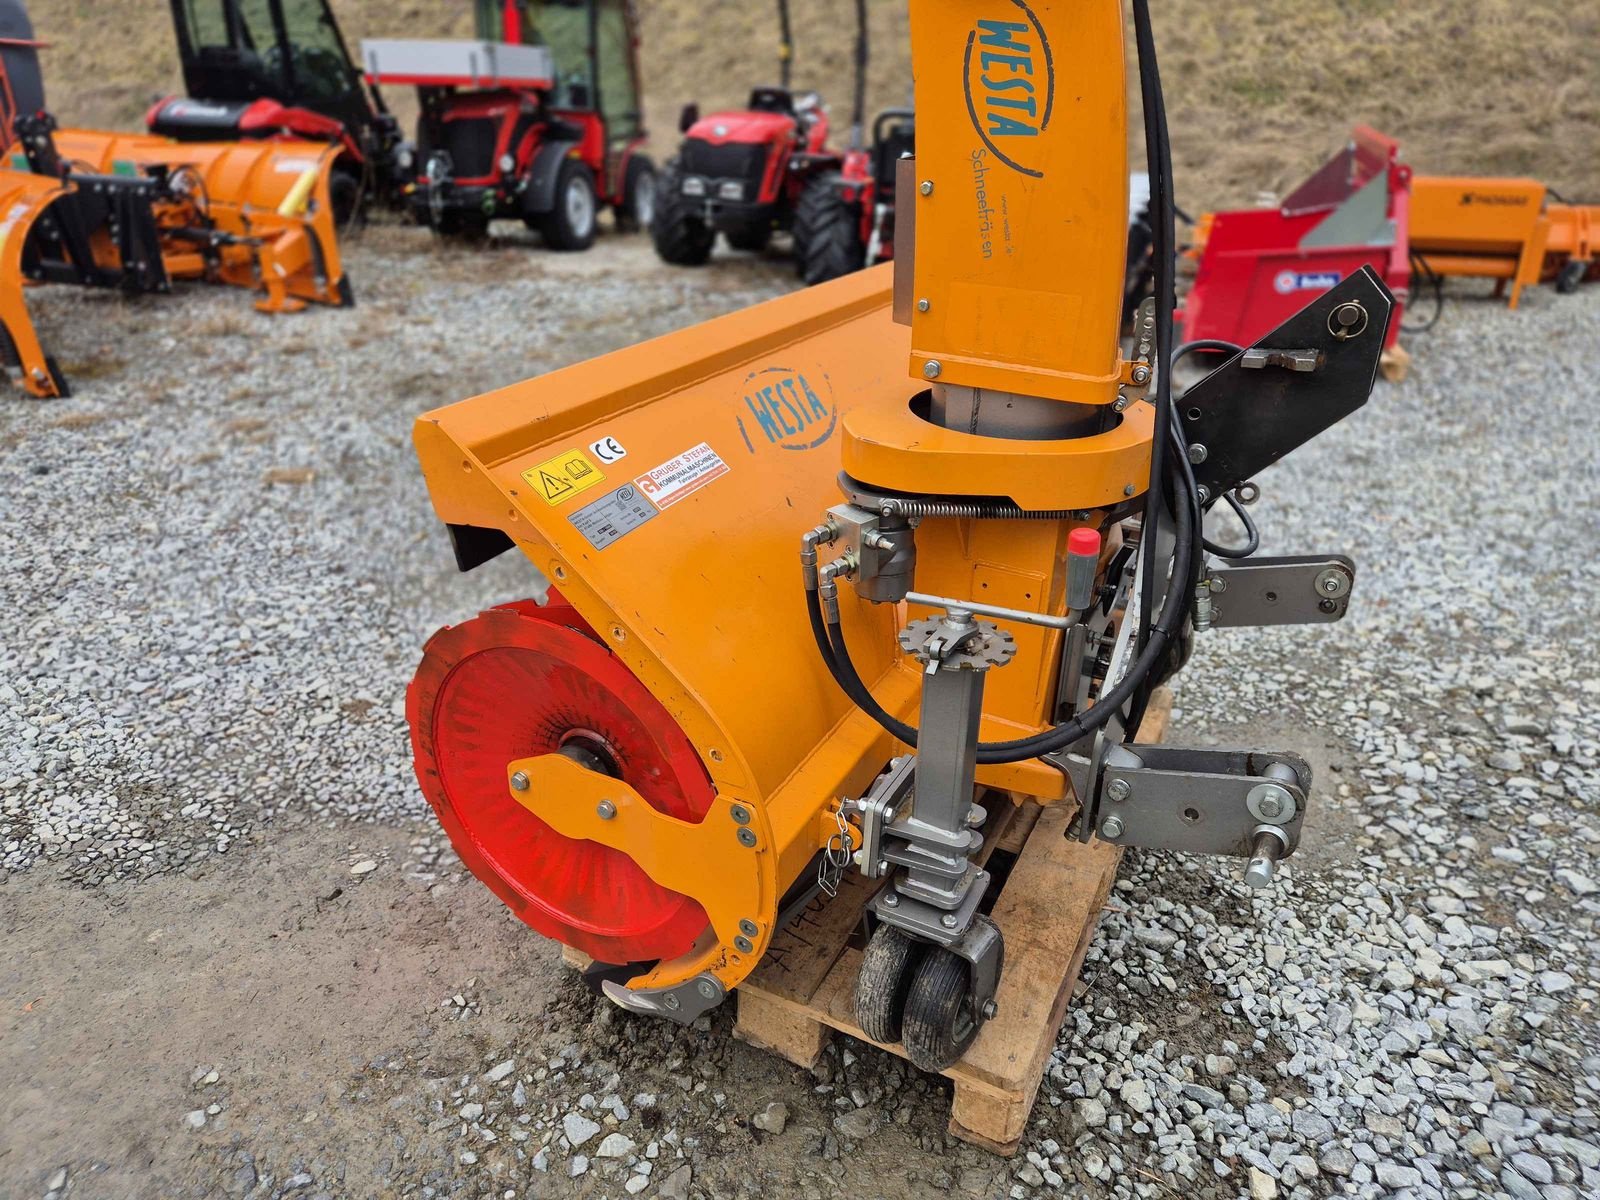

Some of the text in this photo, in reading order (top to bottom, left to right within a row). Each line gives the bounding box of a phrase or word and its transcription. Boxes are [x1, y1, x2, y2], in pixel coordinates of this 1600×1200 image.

[977, 19, 1039, 136] WESTA
[971, 148, 995, 260] Schneefräsen
[744, 374, 828, 443] WESTA
[595, 438, 625, 460] CE
[650, 445, 710, 480] GRUBER STEFAN
[658, 453, 717, 489] KOMMUNALMASCHINEN
